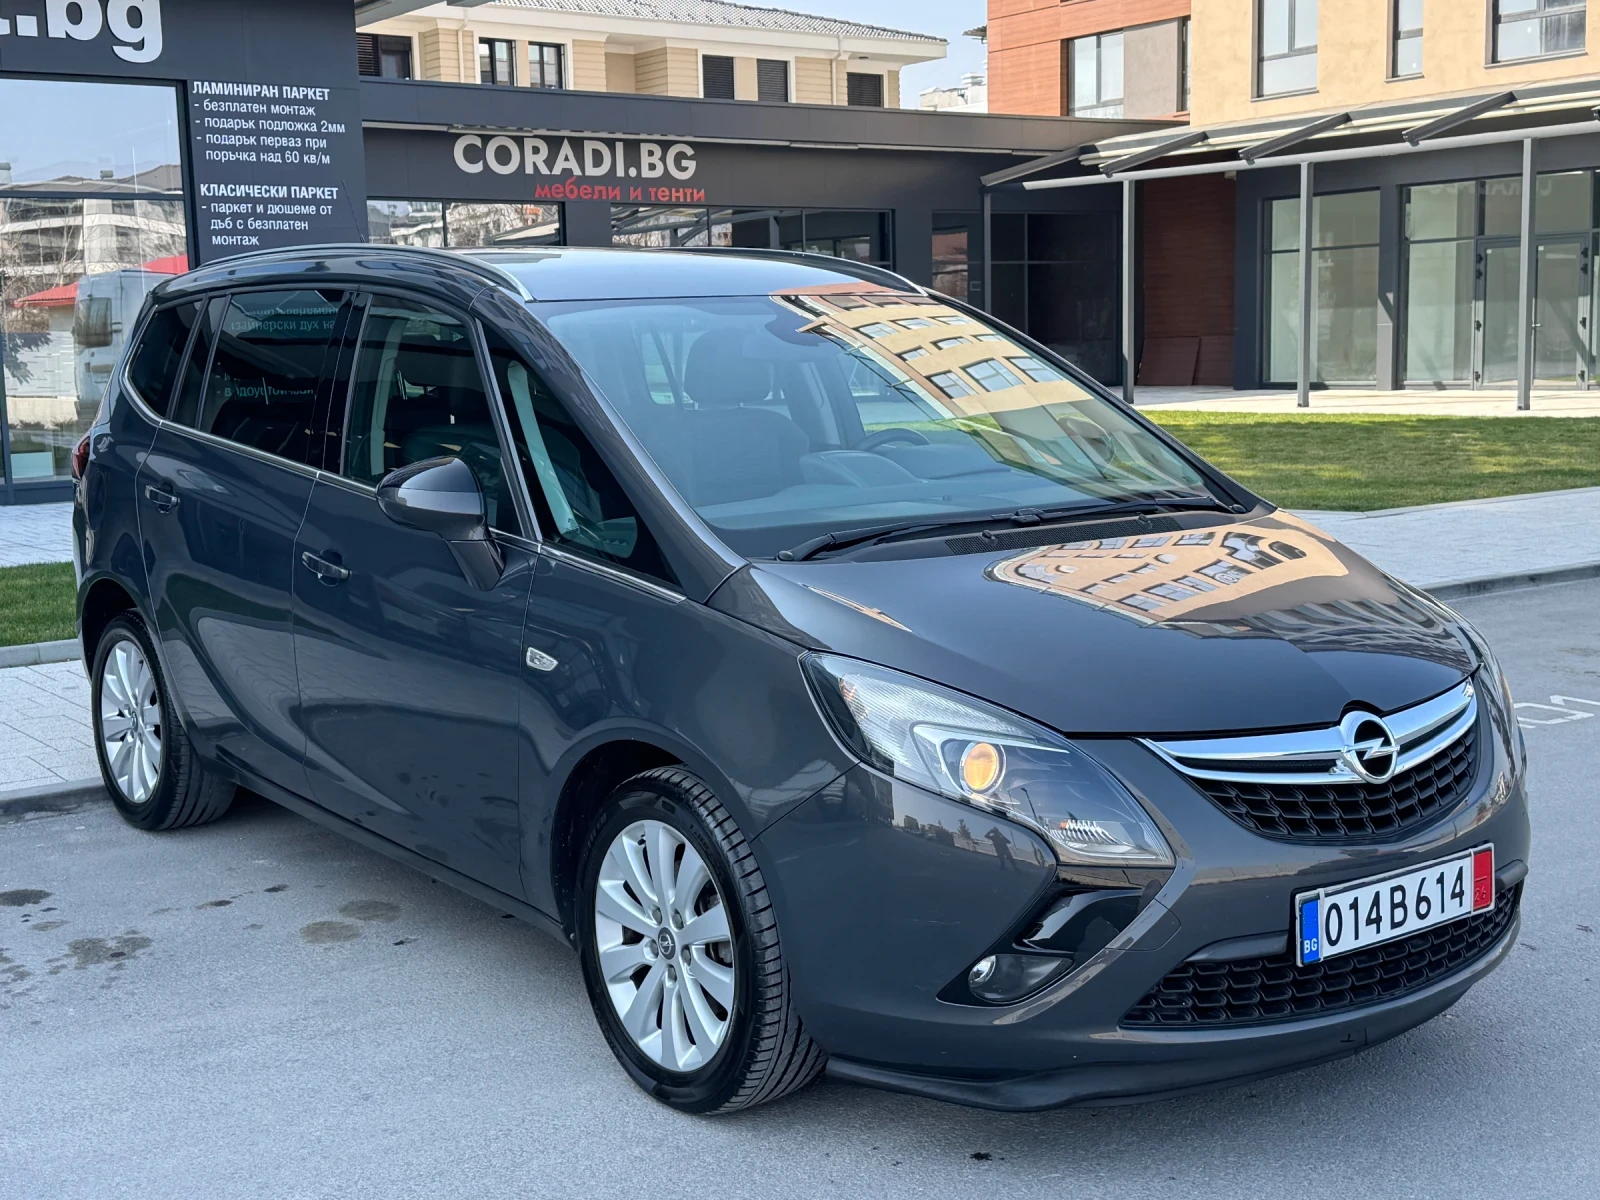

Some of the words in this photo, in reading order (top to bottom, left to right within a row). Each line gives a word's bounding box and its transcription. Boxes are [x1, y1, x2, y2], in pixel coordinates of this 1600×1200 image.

[0, 0, 163, 63] .bg
[192, 81, 279, 99] ЛАМИНИРАН
[282, 86, 330, 101] ПАРКЕТ
[203, 99, 267, 114] безплатен
[270, 105, 316, 116] монтаж
[204, 118, 255, 131] подарък
[259, 120, 317, 133] подложка
[320, 120, 346, 133] 2мм
[205, 134, 257, 148] подарък
[260, 136, 302, 149] перваз
[305, 138, 327, 151] при
[205, 150, 257, 164] поръчка
[260, 152, 282, 164] над
[285, 151, 300, 163] 60
[303, 152, 331, 165] кв/м
[453, 134, 697, 180] CORADI.BG
[200, 183, 287, 198] КЛАСИЧЕСКИ
[290, 186, 338, 200] ПАРКЕТ
[534, 176, 621, 201] мебели
[629, 186, 642, 201] и
[648, 186, 706, 203] тенти
[210, 202, 253, 216] паркет
[256, 205, 264, 214] и
[267, 204, 317, 215] дюшеме
[319, 205, 333, 215] от
[210, 217, 233, 230] дъб
[236, 219, 244, 229] с
[247, 217, 309, 230] безплатен
[212, 235, 260, 246] монтаж
[299, 320, 320, 332] дух
[1324, 865, 1465, 947] 014B614
[1303, 937, 1318, 954] BG
